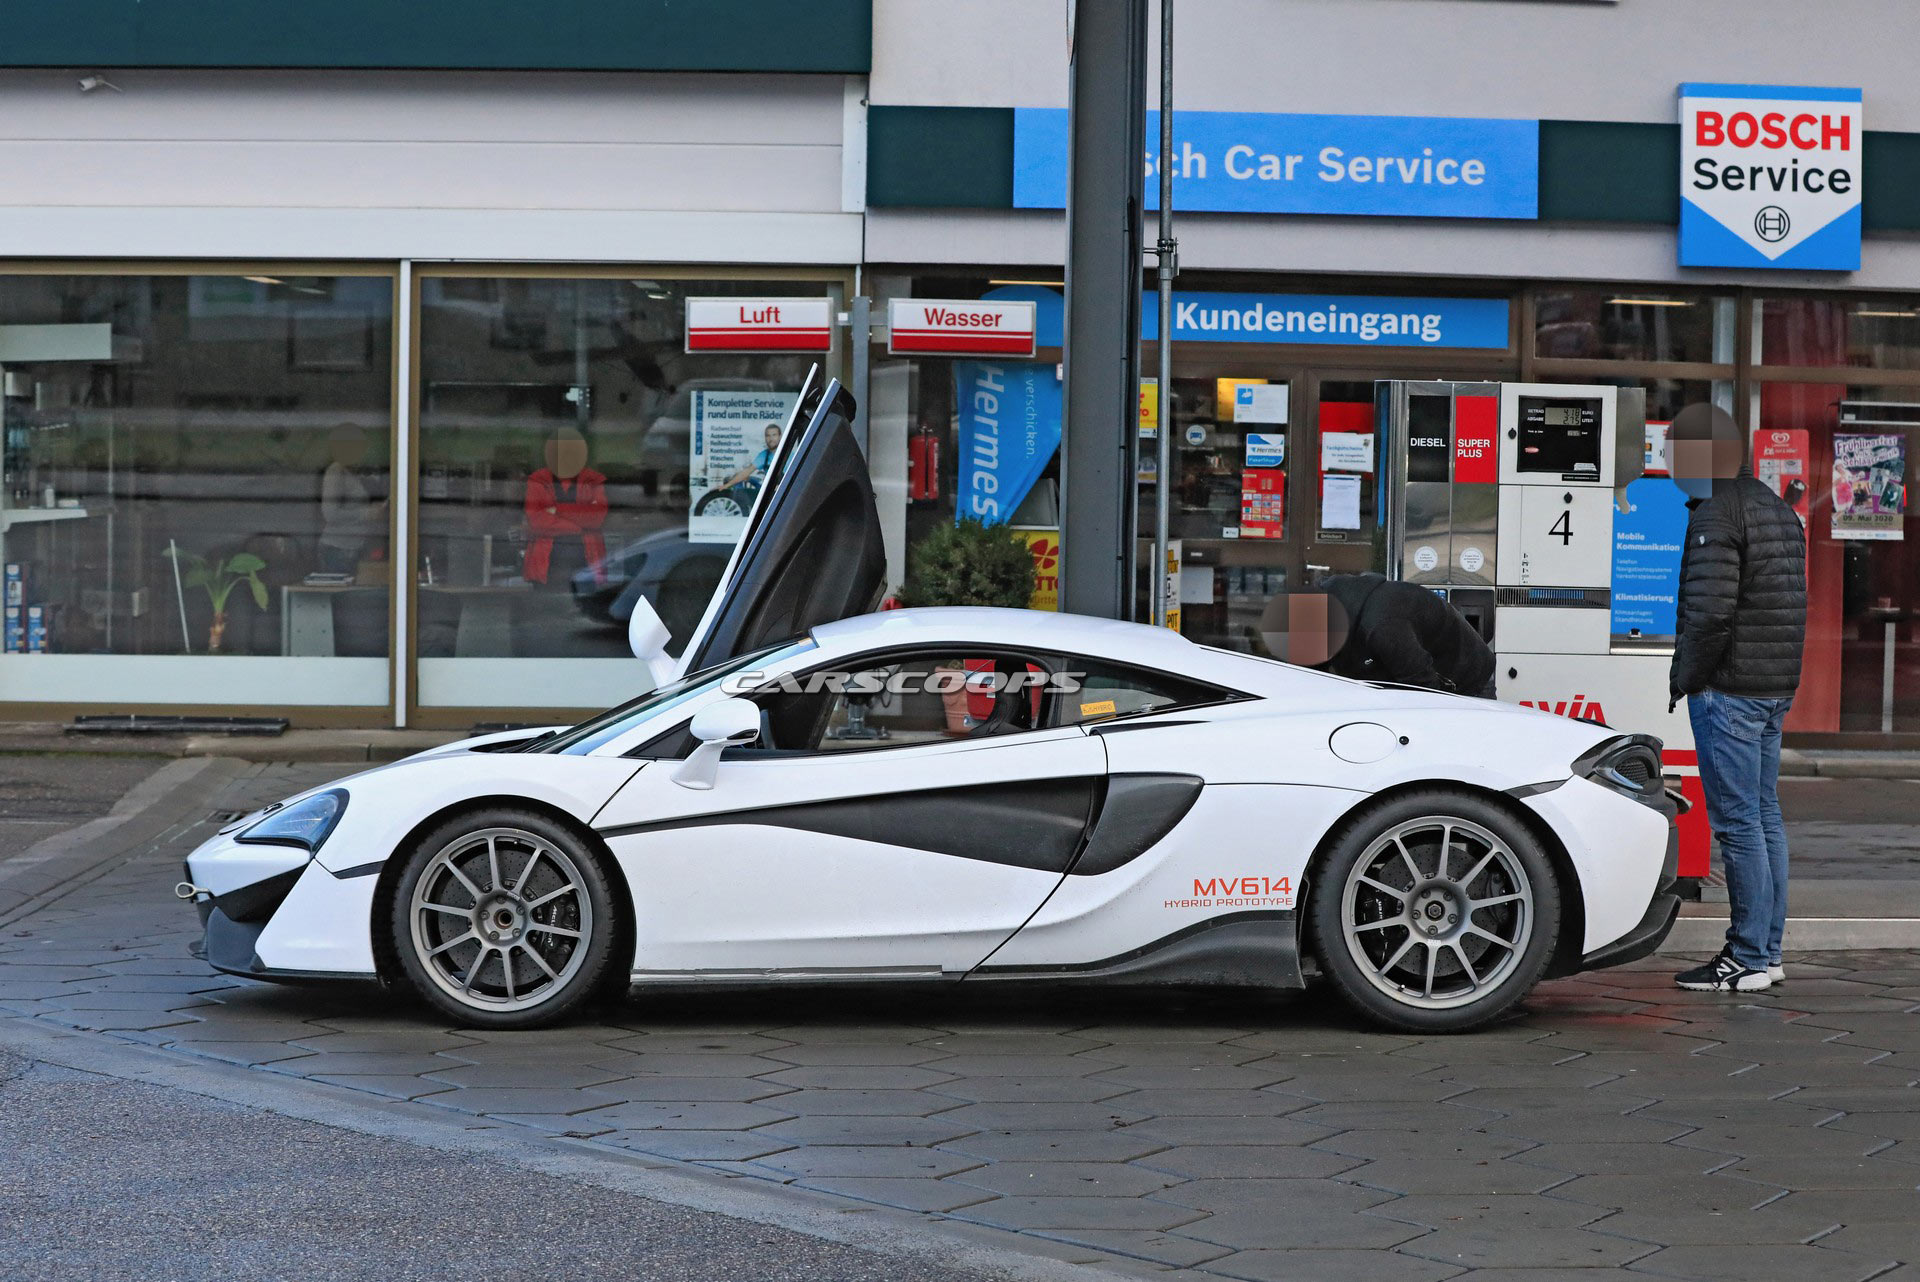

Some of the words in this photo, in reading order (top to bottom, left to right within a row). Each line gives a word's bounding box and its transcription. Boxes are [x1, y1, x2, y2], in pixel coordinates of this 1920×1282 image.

[1696, 111, 1850, 151] BOSCH
[1224, 144, 1303, 181] Car
[1318, 147, 1486, 185] Service
[1693, 158, 1851, 194] Service
[739, 306, 781, 324] Luft
[924, 308, 1003, 327] Wasser
[1176, 302, 1442, 342] Kundeneingang
[707, 398, 753, 409] Kompletter
[754, 398, 785, 408] Service
[707, 410, 727, 419] rund
[742, 410, 758, 420] Ihre
[759, 410, 783, 420] Räder
[1025, 379, 1038, 459] verschicken.
[973, 365, 1004, 517] Hermes
[1410, 437, 1446, 447] DIESEL
[1457, 438, 1491, 448] SUPER
[1457, 448, 1483, 458] PLUS
[1548, 510, 1574, 545] 4
[1616, 532, 1645, 540] Mobile
[1616, 543, 1681, 551] Kommunikation
[1615, 593, 1675, 604] Klimatisierung
[1193, 877, 1293, 897] MV614
[1164, 899, 1212, 908] HYBRID
[1216, 897, 1293, 907] PROTOTYPE
